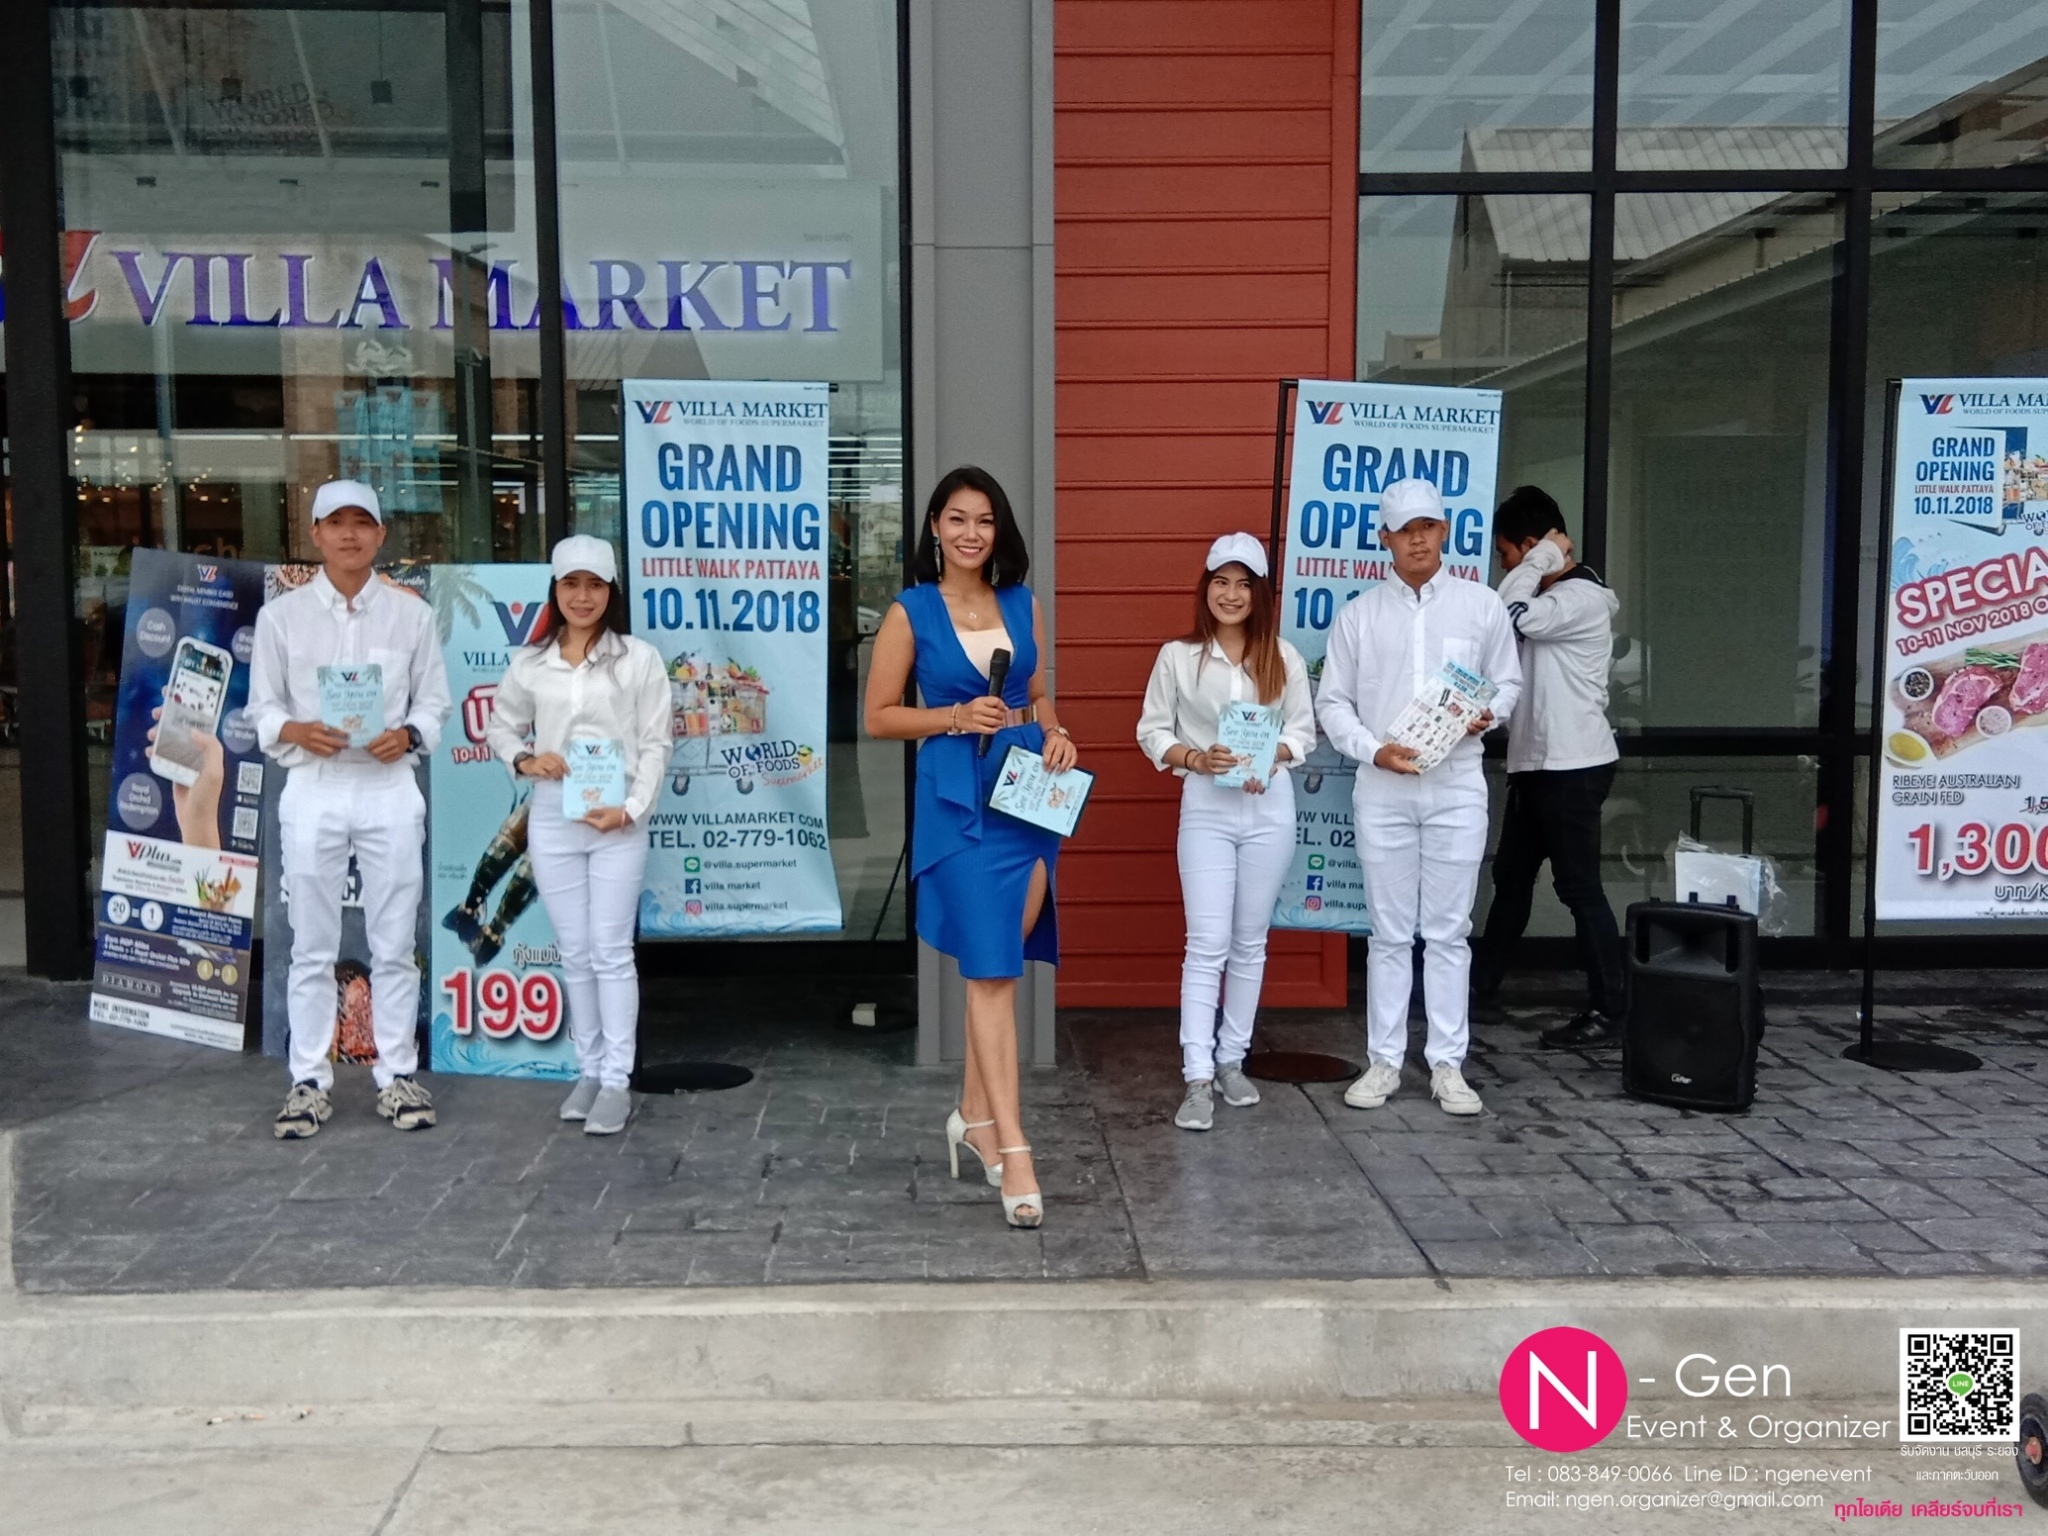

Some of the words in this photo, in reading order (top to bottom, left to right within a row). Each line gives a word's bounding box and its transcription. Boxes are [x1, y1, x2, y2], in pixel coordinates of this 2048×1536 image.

[109, 250, 411, 330] VILLA
[429, 258, 852, 333] MARKET
[676, 401, 735, 417] VILLA
[742, 402, 828, 418] MARKET
[1959, 393, 2011, 407] VILLA
[2016, 393, 2048, 407] MA
[761, 419, 825, 427] SUPERMARKET
[1350, 402, 1406, 420] VILLA
[1413, 406, 1499, 426] MARKET
[1354, 419, 1386, 428] WORLD
[1387, 420, 1398, 428] OF
[1400, 421, 1430, 431] FOODS
[1431, 423, 1495, 435] SUPERMARKET
[1932, 437, 1995, 457] GRAND
[658, 442, 802, 493] GRAND
[1323, 443, 1470, 497] GRAND
[1916, 461, 1994, 481] OPENING
[1915, 484, 1937, 494] LITTLE
[1938, 484, 1959, 494] WALK
[1961, 485, 1994, 494] PATTAYA
[1914, 496, 1993, 515] 10.11.2018
[641, 500, 820, 551] OPENING
[642, 557, 693, 578] LITTLE
[696, 558, 740, 579] WALK
[745, 559, 820, 580] PATTAYA
[1297, 556, 1348, 579] LITTLE
[1353, 559, 1393, 581] WAL
[643, 587, 820, 633] 10.11.2018
[1897, 628, 1943, 655] 10-11
[1946, 616, 1985, 640] NOV
[1990, 601, 2031, 627] 2018
[464, 651, 511, 666] VILLA
[453, 745, 492, 764] 10-11
[756, 757, 800, 773] FOODS
[1892, 774, 1935, 789] RIBEYE
[1938, 774, 2020, 789] AUSTRALIAN
[1892, 791, 1937, 805] GRAIN
[1941, 791, 1964, 805] FED
[648, 830, 696, 849] TEL.
[703, 828, 828, 851] 02-779-1062
[705, 881, 725, 890] villa
[727, 881, 761, 890] market
[1326, 880, 1346, 889] villa
[112, 901, 126, 914] 20
[102, 973, 163, 995] DIAMOND
[443, 969, 560, 1036] 199
